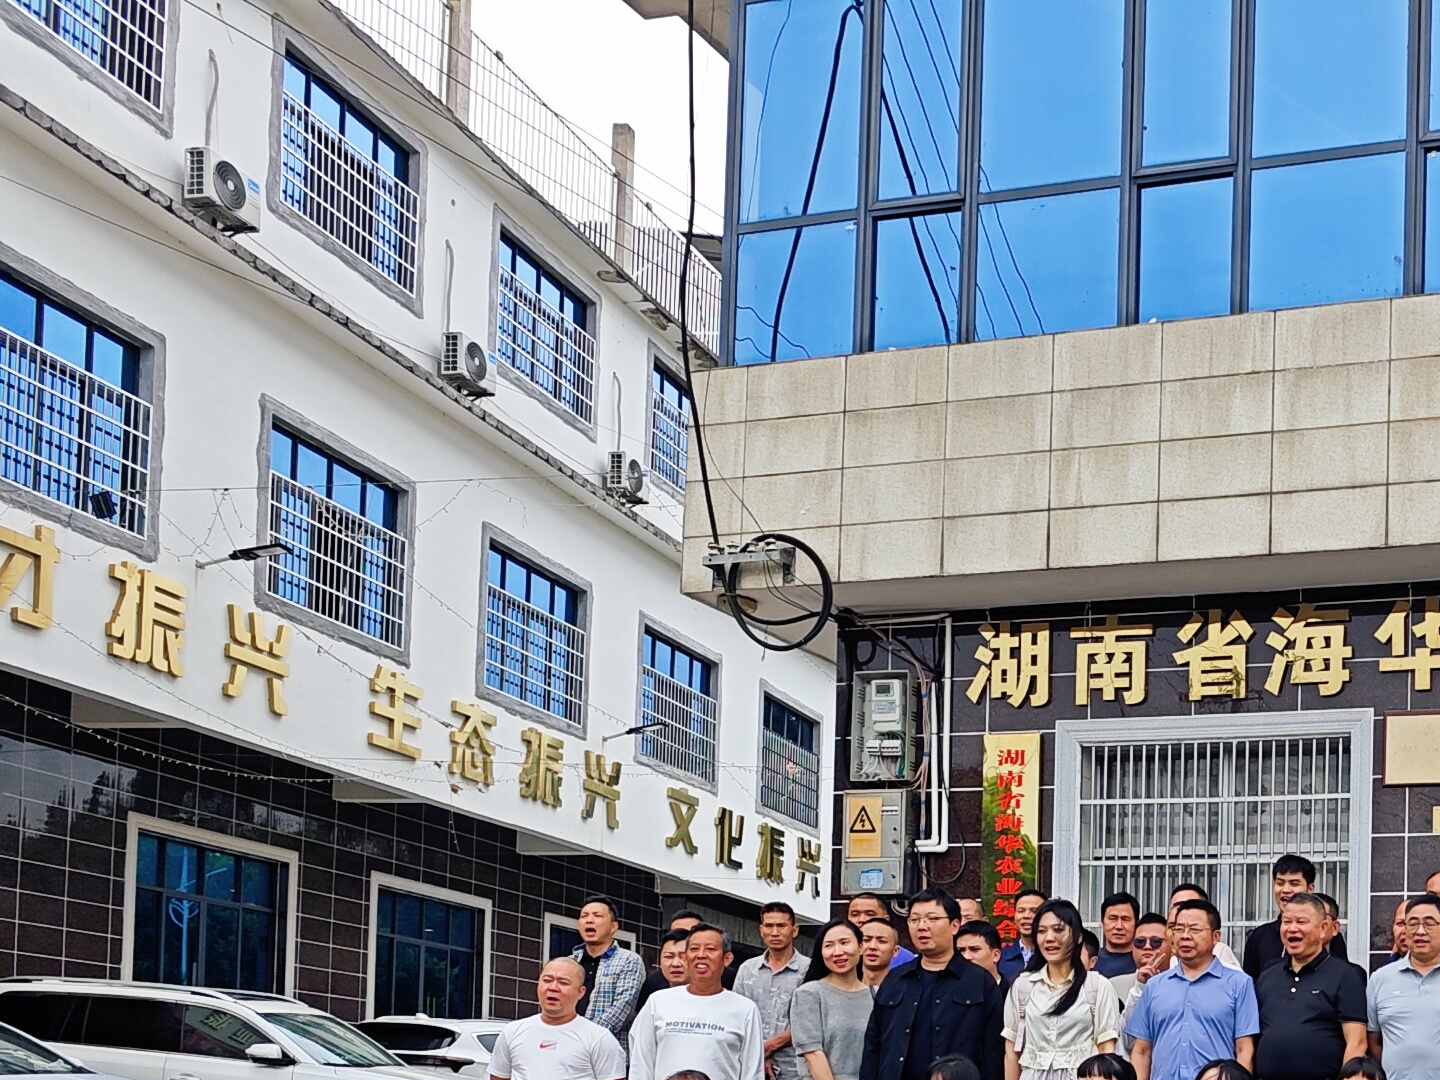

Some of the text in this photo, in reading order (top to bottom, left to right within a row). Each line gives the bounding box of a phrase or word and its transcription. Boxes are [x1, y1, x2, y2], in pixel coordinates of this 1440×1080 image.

[368, 664, 622, 830] 生态振兴
[665, 787, 821, 899] 文化振兴
[992, 749, 1026, 947] 湖南省海华农业综合
[665, 1021, 725, 1032] MOTIVATION
